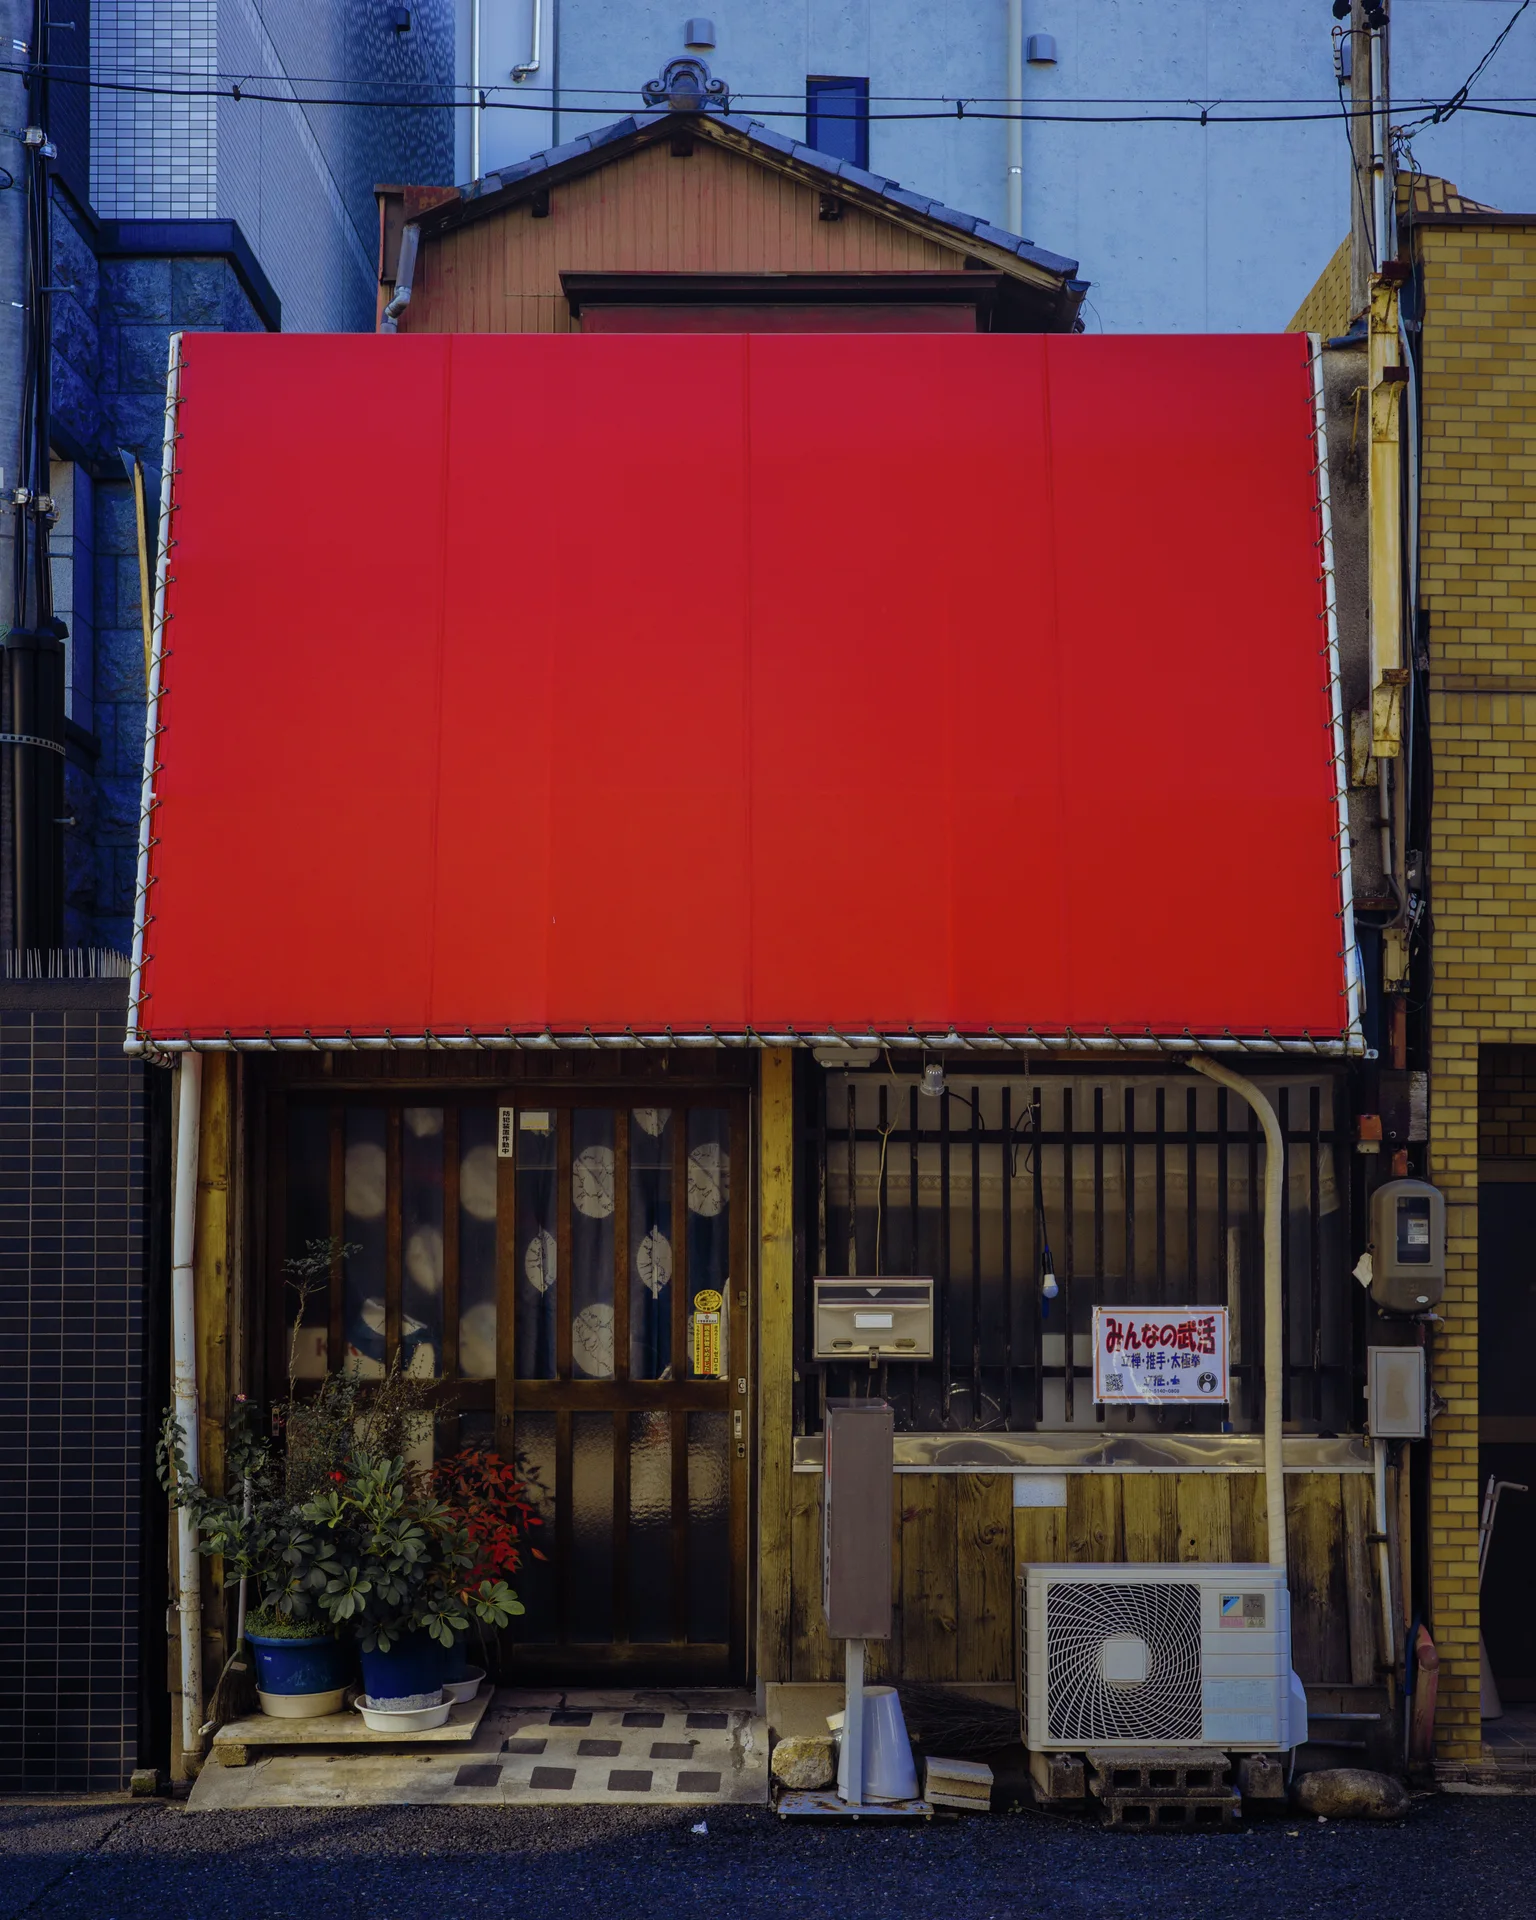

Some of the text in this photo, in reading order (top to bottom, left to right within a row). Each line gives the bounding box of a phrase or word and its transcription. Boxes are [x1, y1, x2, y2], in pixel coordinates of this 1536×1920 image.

[502, 1111, 510, 1154] 防犯装置作動中
[1105, 1316, 1216, 1354] みんなの武活
